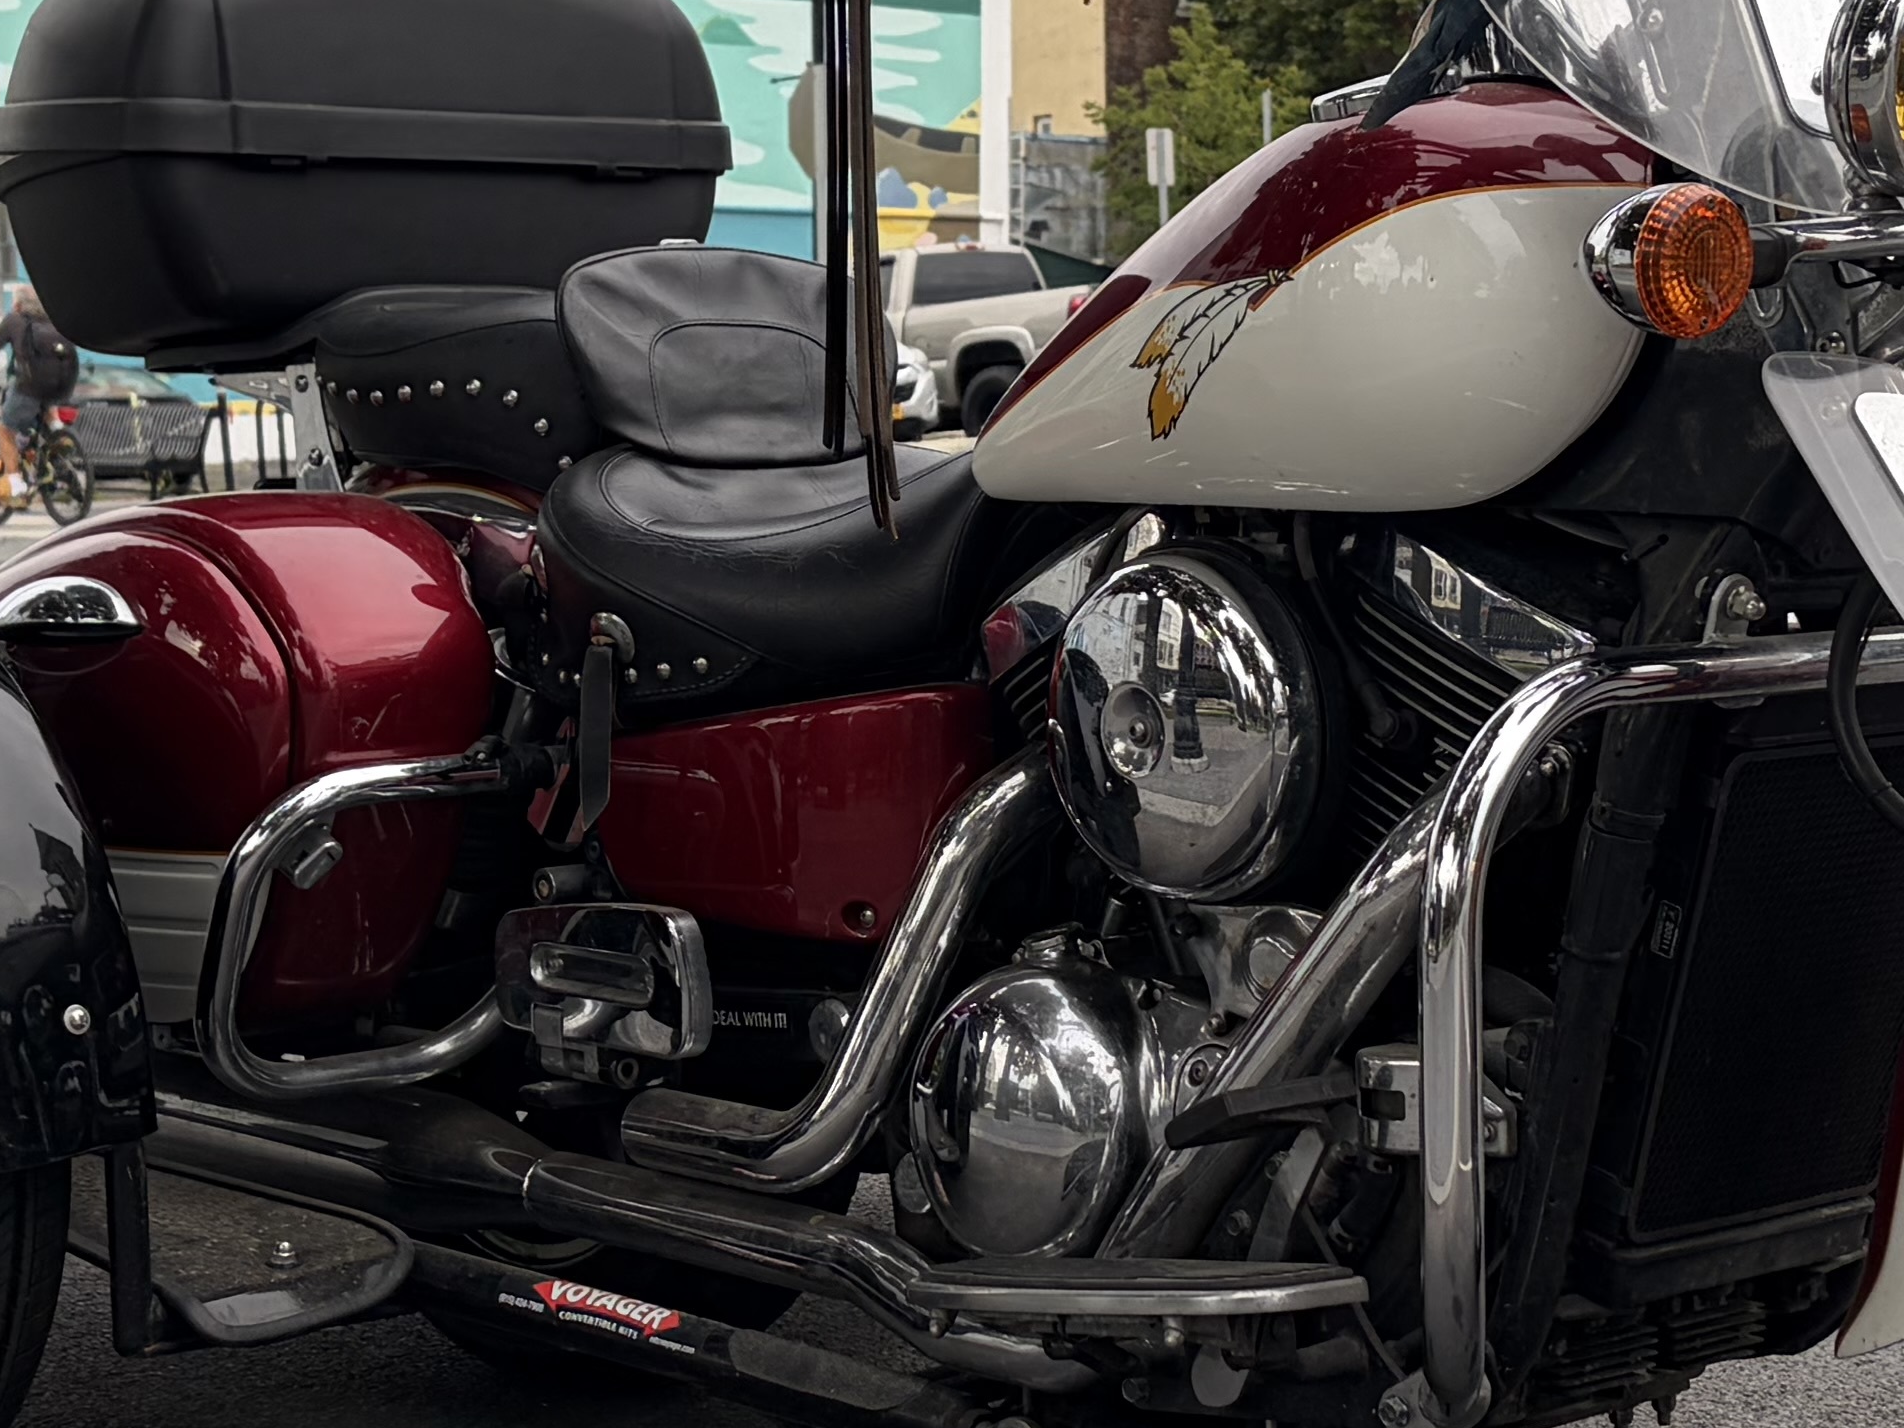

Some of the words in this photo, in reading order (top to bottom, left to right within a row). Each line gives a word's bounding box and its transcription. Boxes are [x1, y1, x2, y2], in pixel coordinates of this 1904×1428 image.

[712, 1010, 741, 1026] DEAL
[742, 1011, 772, 1028] WITH
[774, 1012, 788, 1029] IT!
[550, 1280, 672, 1330] VOYAGER
[558, 1311, 617, 1333] CONVERTIBLE
[618, 1325, 638, 1340] KITS
